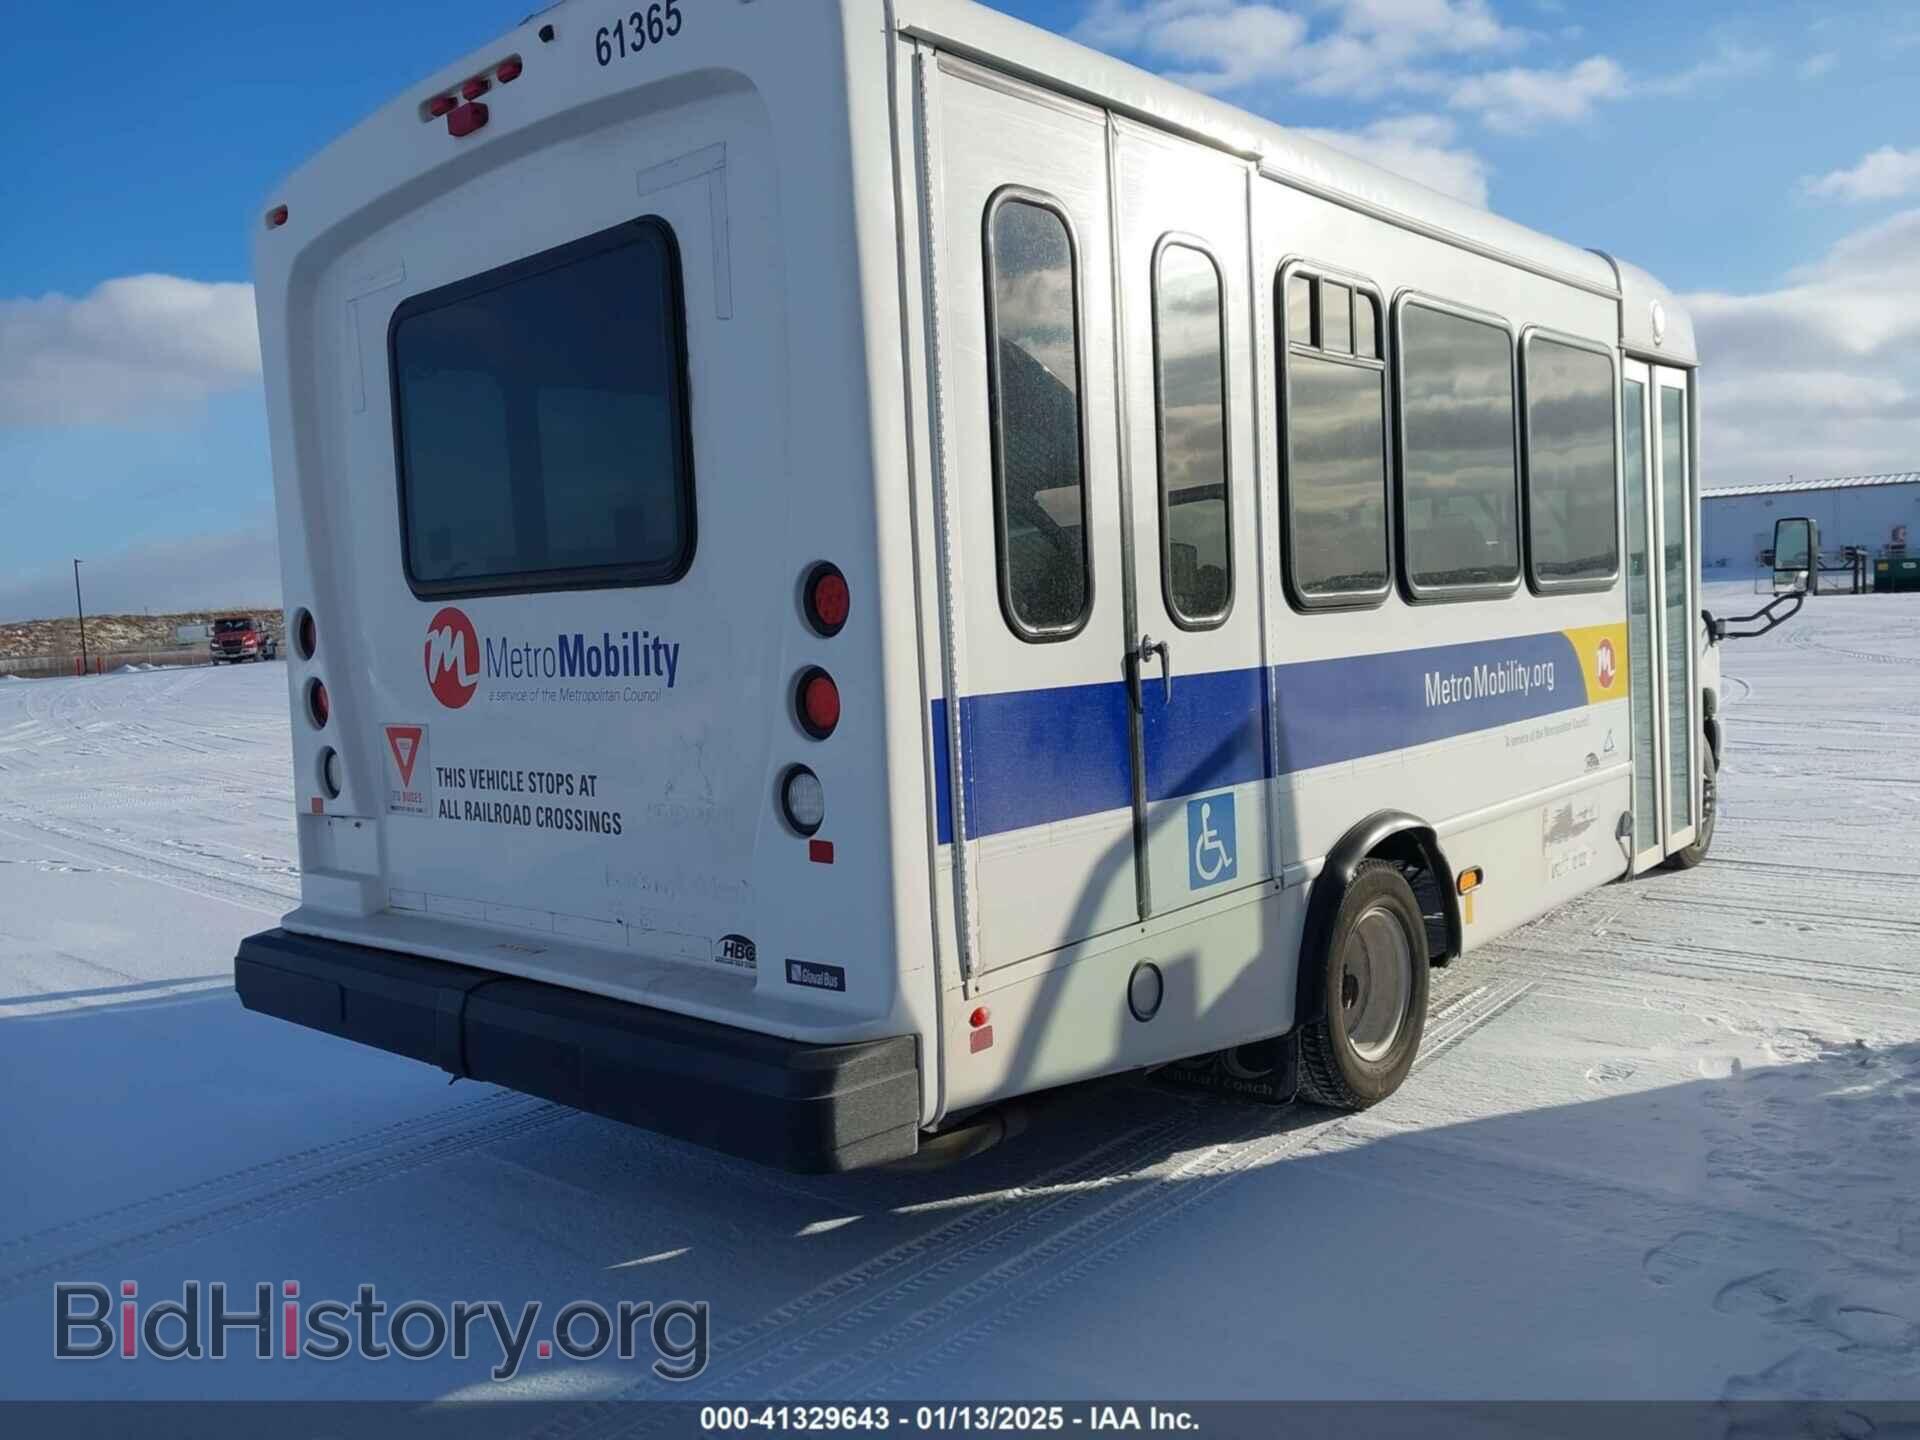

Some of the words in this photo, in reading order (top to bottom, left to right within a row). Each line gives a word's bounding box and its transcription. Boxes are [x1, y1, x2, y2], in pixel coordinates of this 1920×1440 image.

[595, 0, 682, 66] 61365
[486, 631, 680, 688] MetroMobility
[541, 687, 556, 701] the
[559, 686, 620, 704] Metropolitan
[623, 685, 662, 702] Council
[1424, 659, 1554, 707] MetroMobility.org
[436, 767, 466, 788] THIS
[469, 769, 524, 793] VEHICLE
[528, 771, 574, 795] STOPS
[579, 775, 597, 797] AT
[438, 799, 461, 820] ALL
[464, 801, 532, 826] RAILROAD
[536, 806, 622, 835] CROSSINGS
